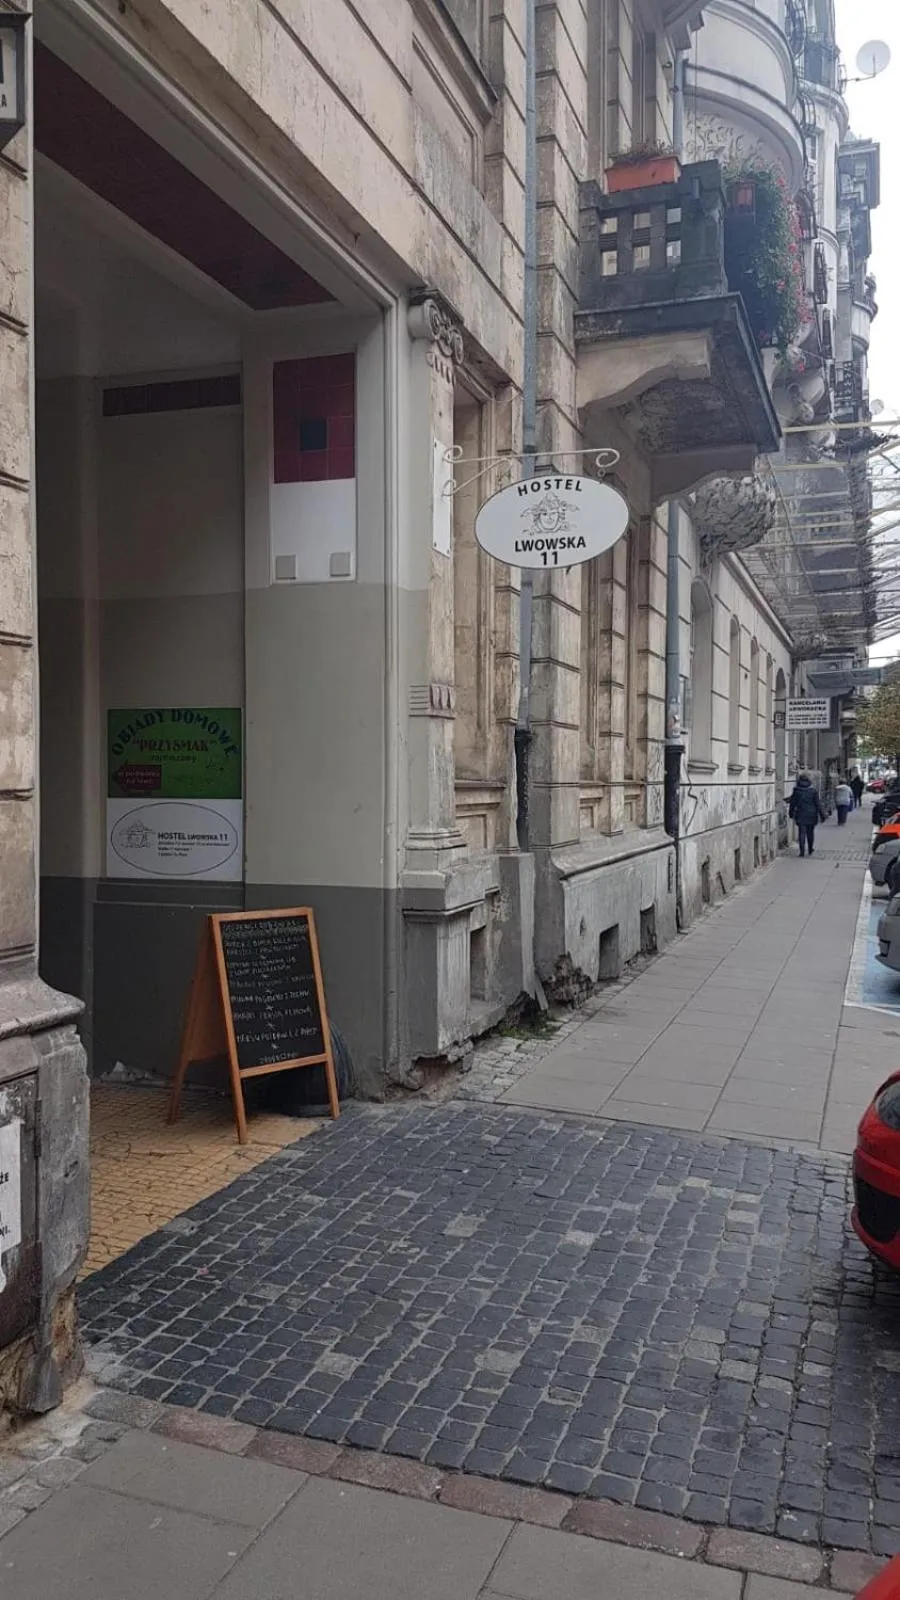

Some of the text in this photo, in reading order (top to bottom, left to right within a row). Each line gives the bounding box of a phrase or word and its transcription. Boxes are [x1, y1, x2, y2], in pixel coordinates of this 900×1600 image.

[517, 478, 582, 497] HOSTEL
[514, 536, 586, 552] LWOWSKA
[540, 552, 558, 565] 11
[111, 709, 241, 757] OBIADY DOMOWE
[157, 832, 228, 841] HOSTEL LWOWSKA 11
